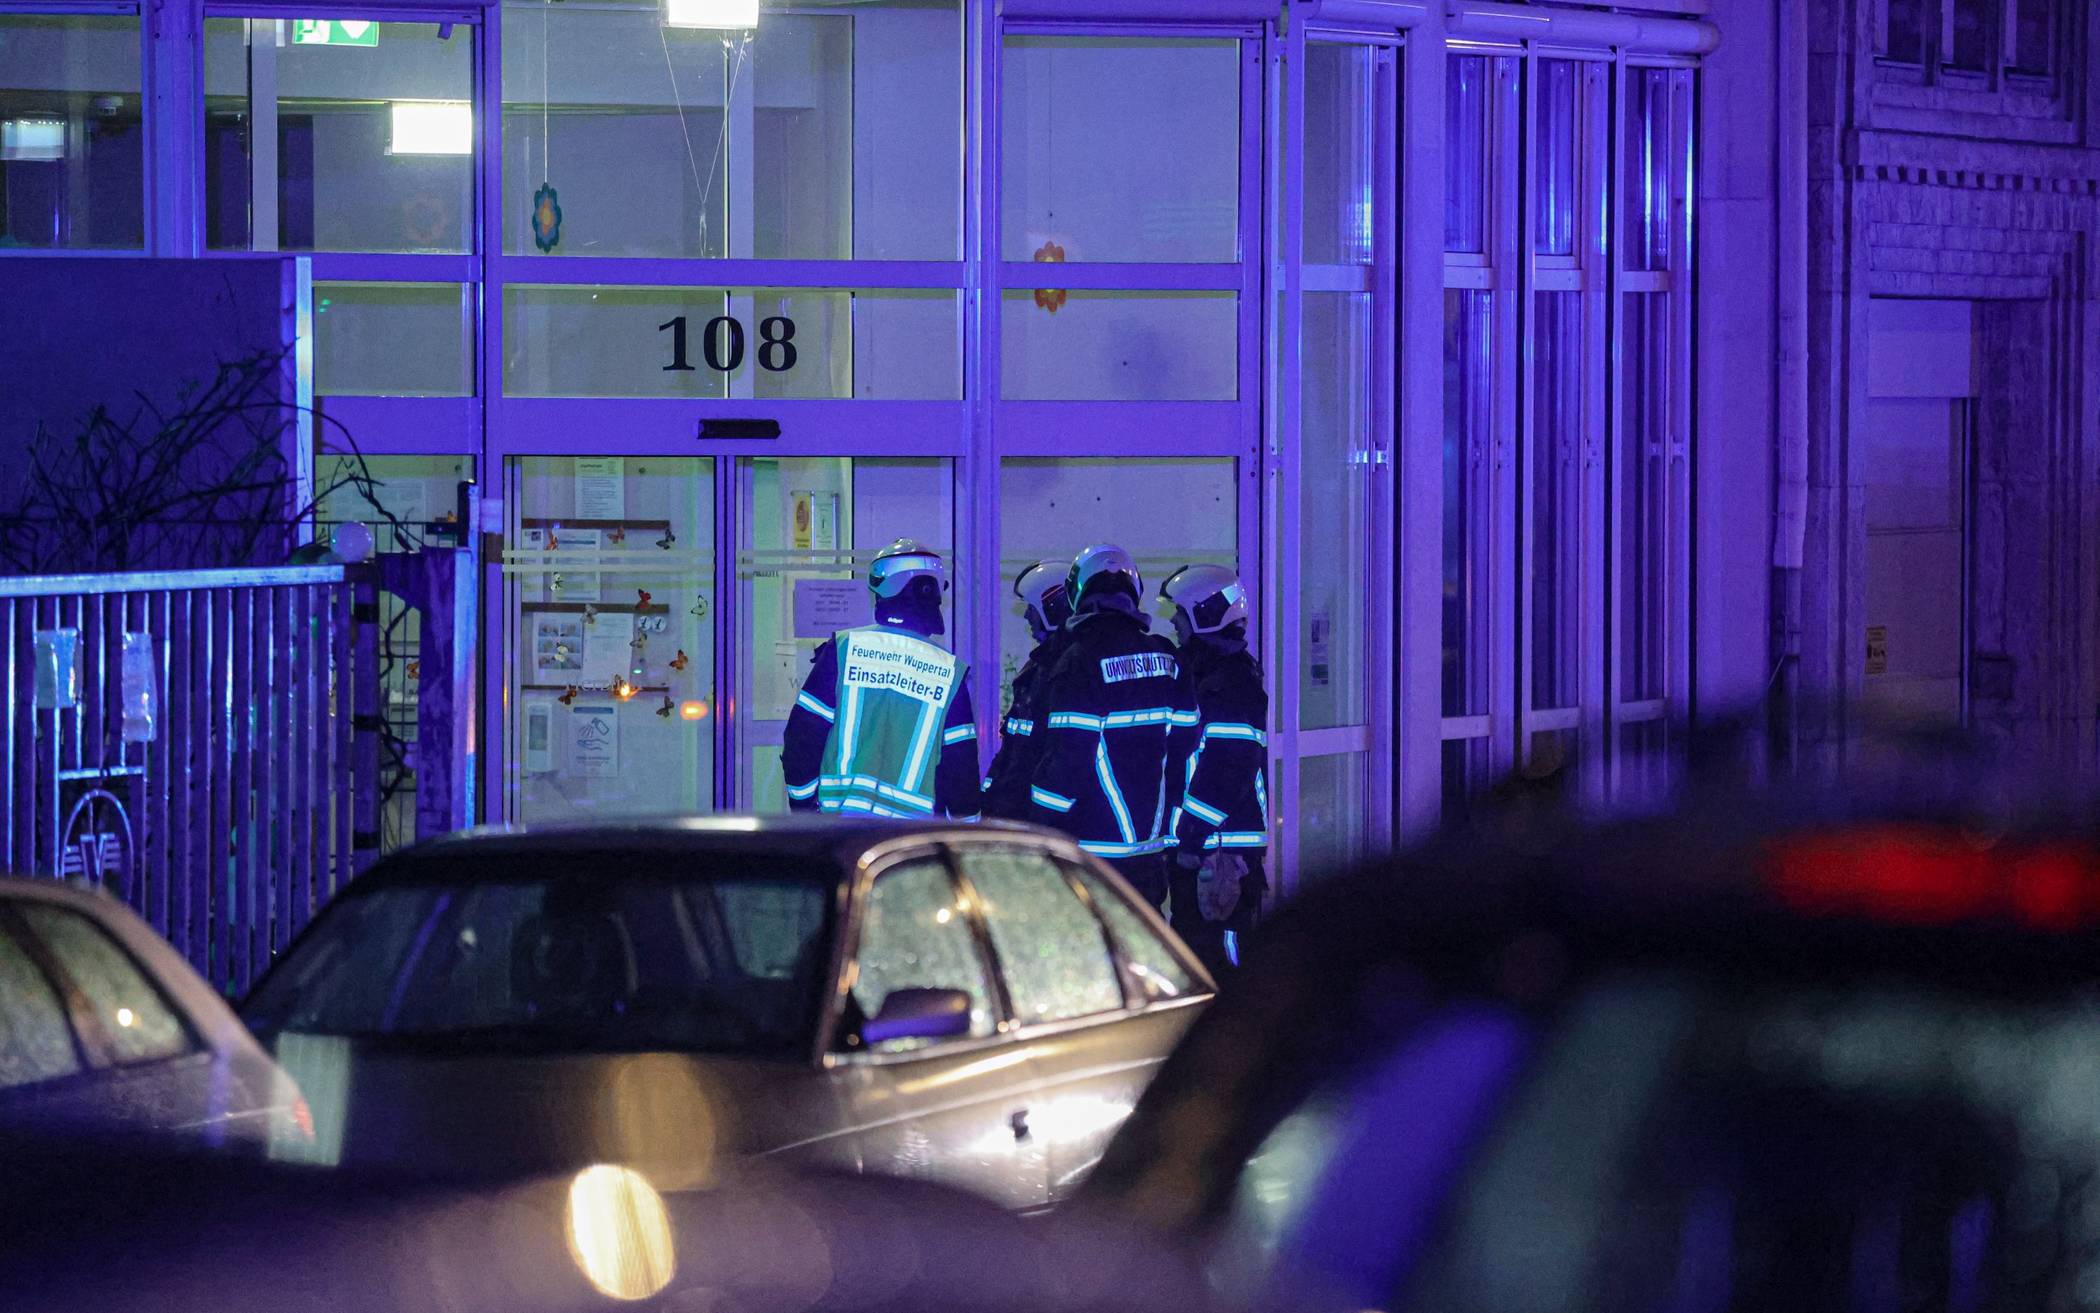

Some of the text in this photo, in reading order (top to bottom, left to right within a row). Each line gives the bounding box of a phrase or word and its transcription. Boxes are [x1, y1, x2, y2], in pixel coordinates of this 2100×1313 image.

[659, 316, 797, 371] 108
[852, 645, 951, 678] Feuerwehr Wuppertal
[848, 666, 944, 701] Einsatzleiter-B
